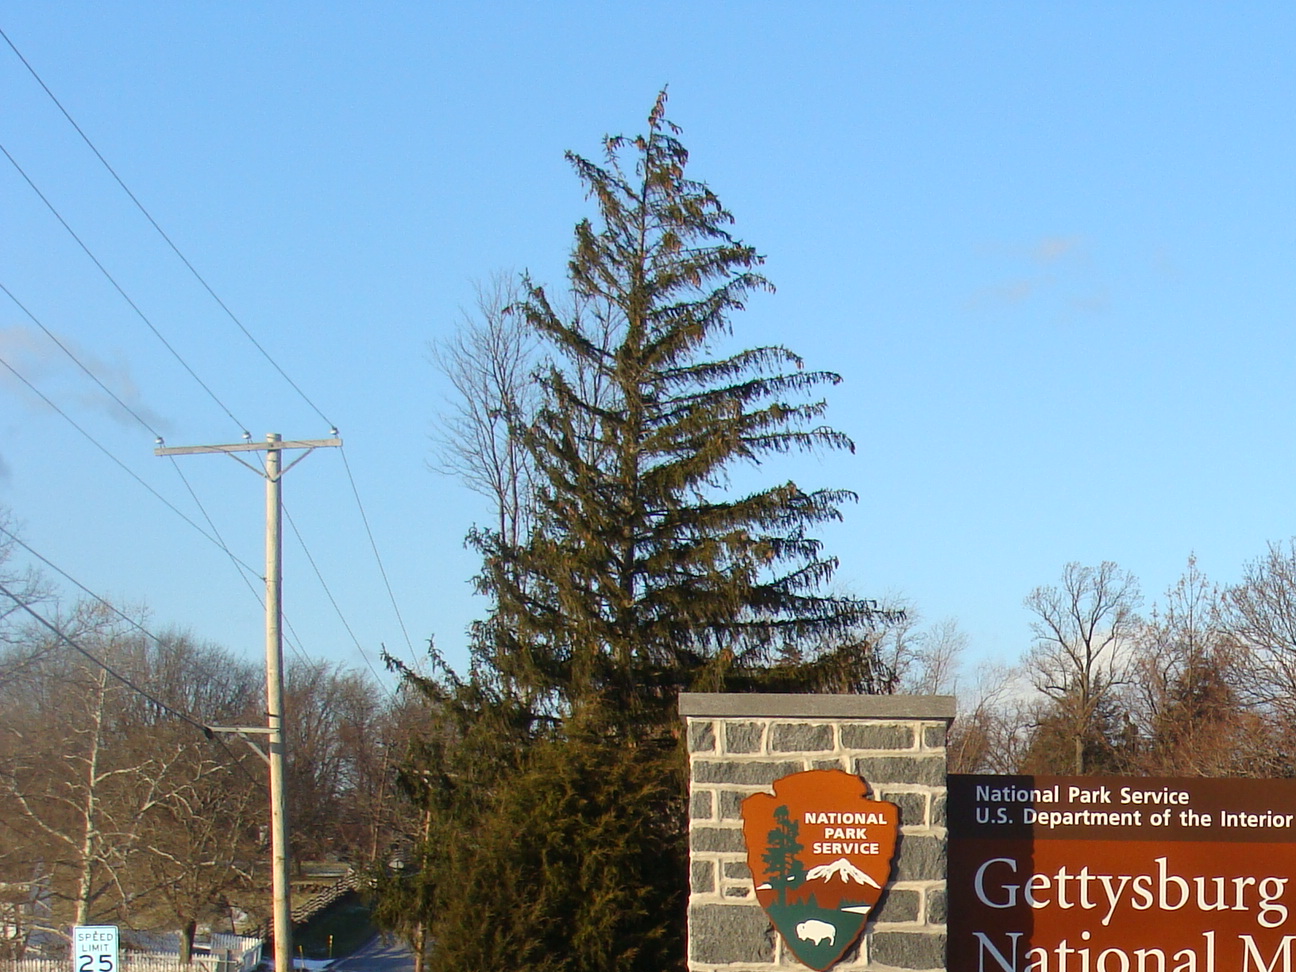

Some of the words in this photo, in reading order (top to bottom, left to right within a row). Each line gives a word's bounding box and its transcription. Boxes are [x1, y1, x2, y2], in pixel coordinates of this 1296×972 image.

[975, 785, 1059, 804] National
[1068, 786, 1111, 804] Park
[1120, 787, 1190, 805] Service
[804, 812, 888, 825] NATIONAL
[975, 808, 1014, 826] U.S.
[1023, 809, 1142, 830] Department
[1150, 809, 1171, 827] of
[1179, 810, 1211, 828] the
[1220, 810, 1294, 828] Interior
[824, 828, 867, 839] PARK
[813, 842, 879, 855] SERVICE
[974, 856, 1290, 928] Gettysburg
[78, 933, 114, 942] SPEED
[81, 944, 109, 952] LIMIT
[79, 954, 113, 972] 25
